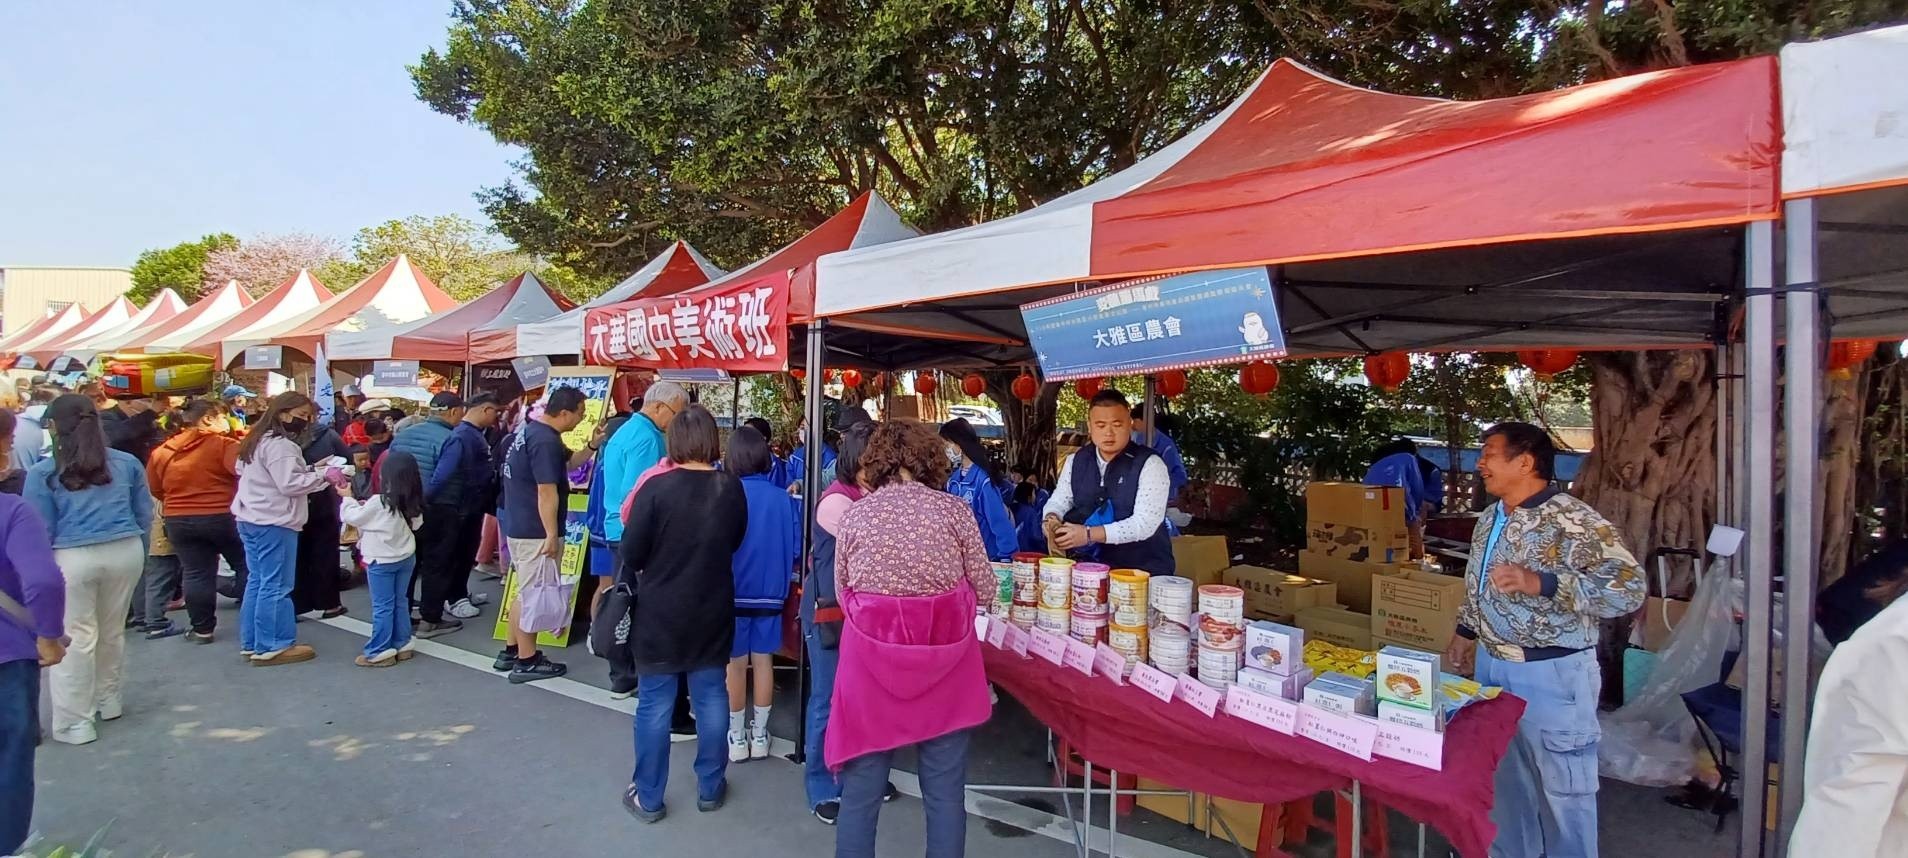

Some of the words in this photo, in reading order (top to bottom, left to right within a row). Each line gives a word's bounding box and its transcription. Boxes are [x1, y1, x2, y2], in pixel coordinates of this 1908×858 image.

[590, 287, 777, 365] 大華國中美術班
[1092, 315, 1183, 349] 大雅區農會
